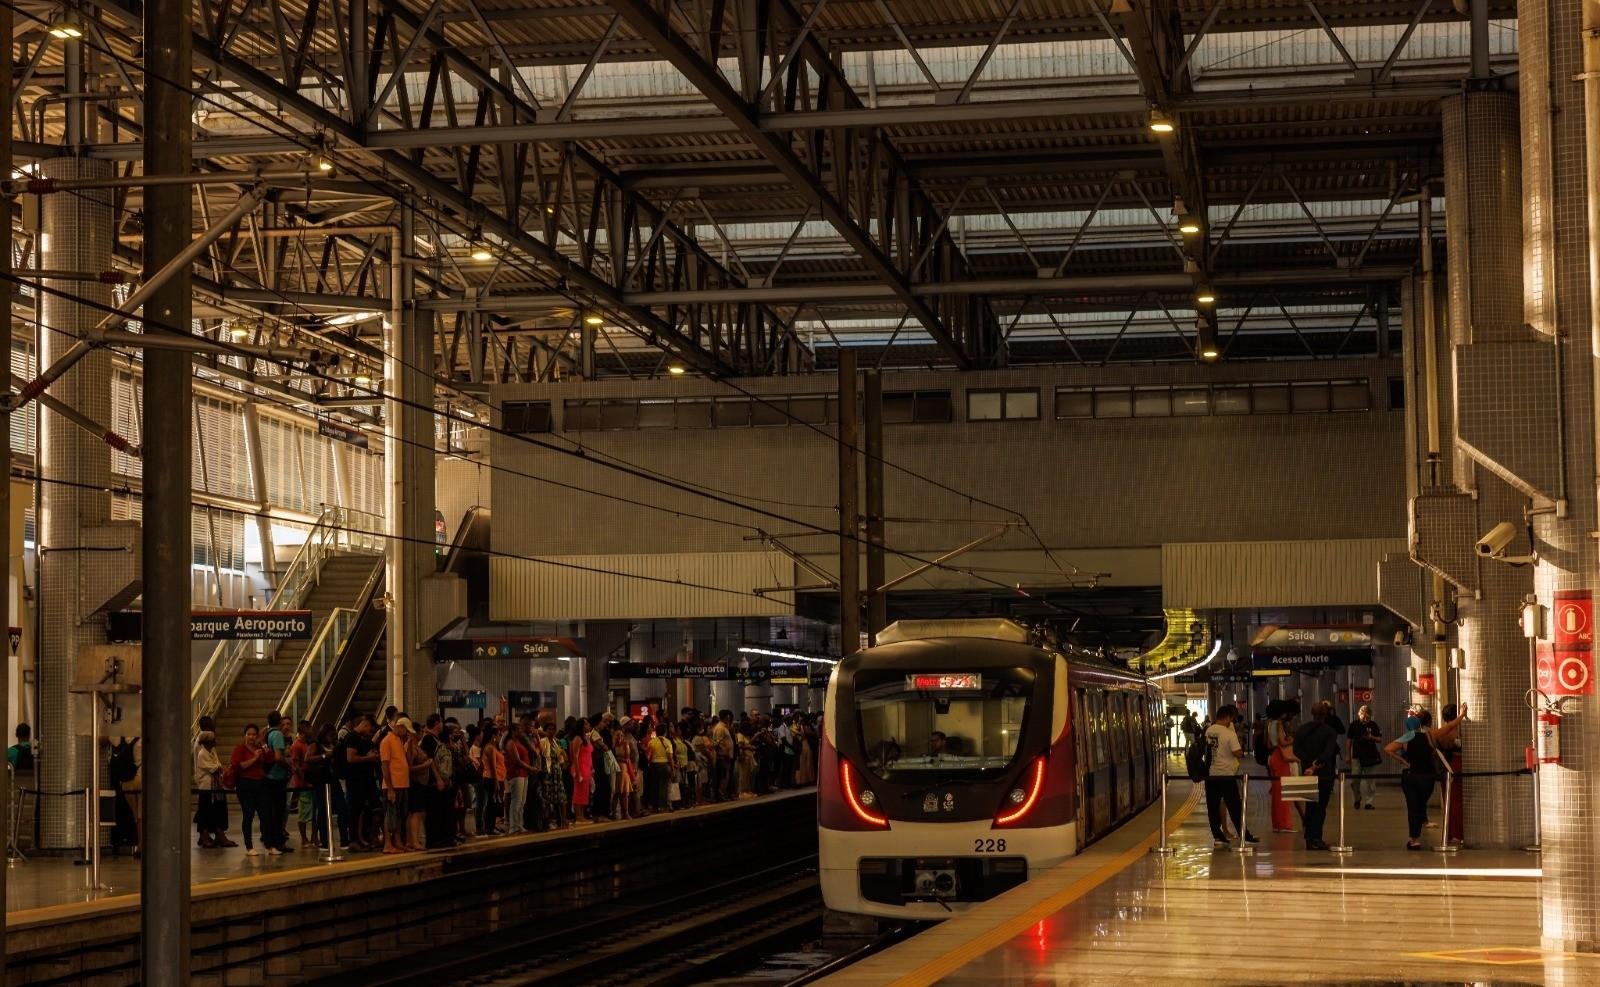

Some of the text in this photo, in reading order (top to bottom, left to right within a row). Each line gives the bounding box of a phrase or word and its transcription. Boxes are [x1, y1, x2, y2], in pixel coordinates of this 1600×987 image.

[234, 617, 306, 633] Aeroporto
[1288, 631, 1315, 641] Saída
[1578, 632, 1592, 640] ABC
[523, 643, 549, 653] Saída
[1272, 654, 1329, 665] Acesso Norte
[683, 664, 725, 674] Aeroporto
[974, 838, 1006, 853] 228
